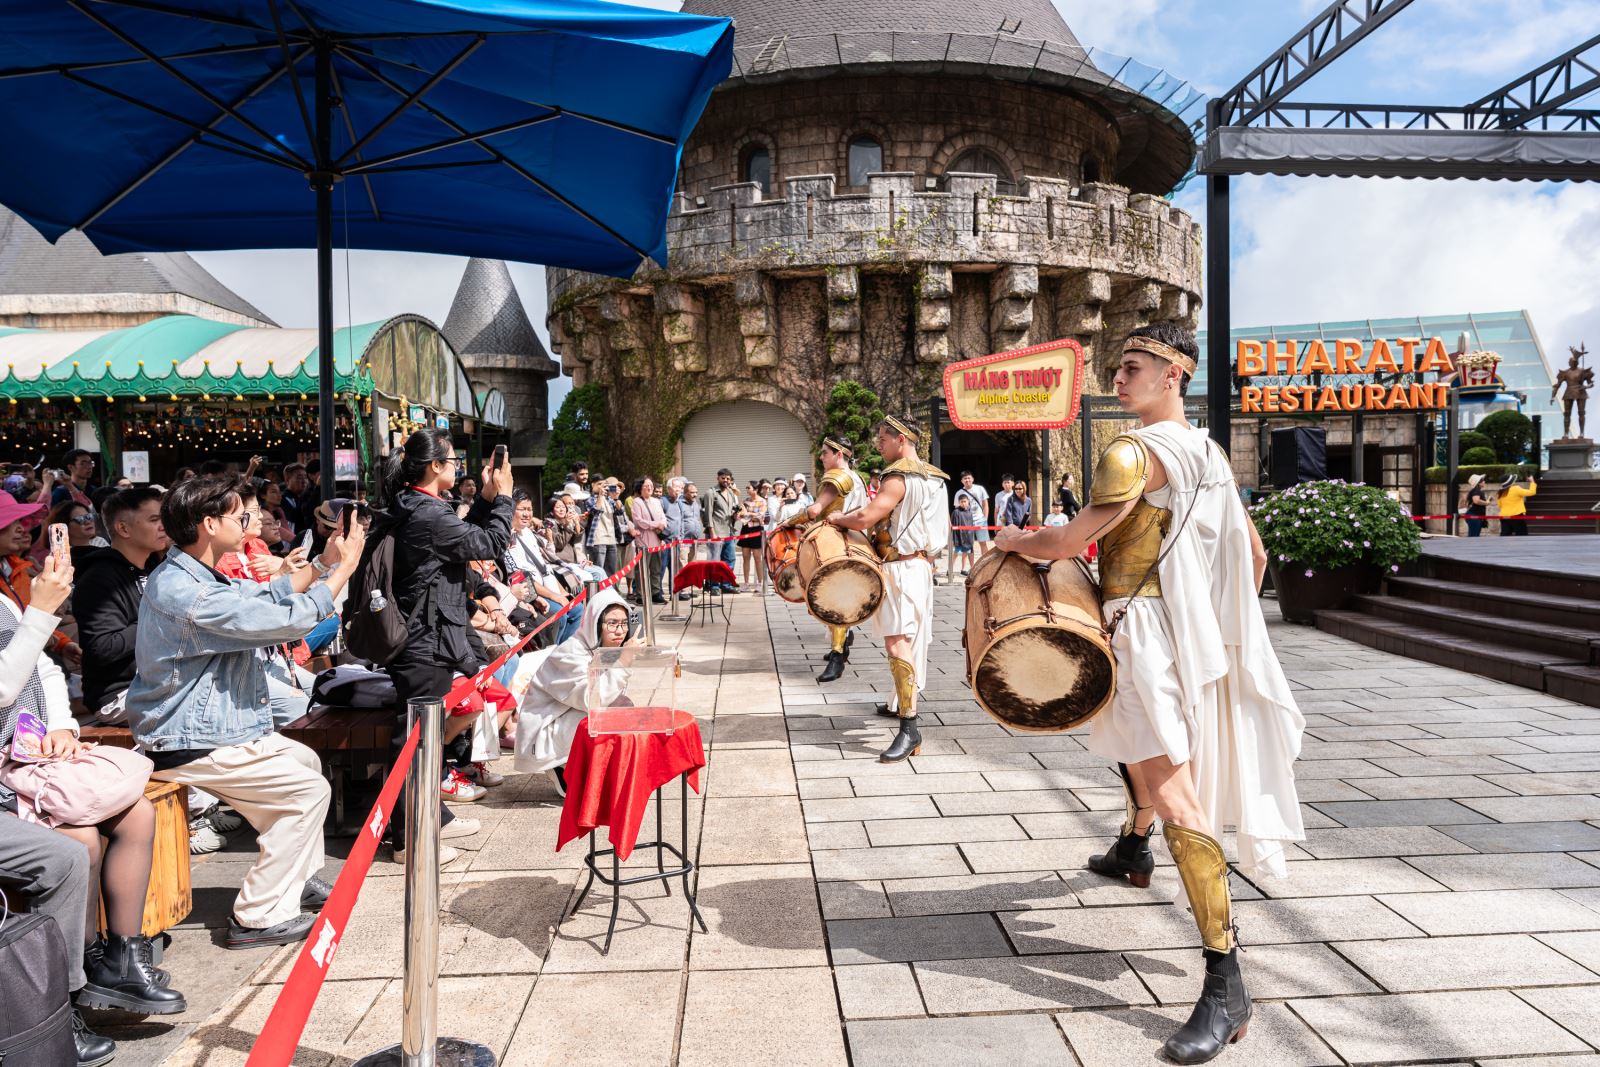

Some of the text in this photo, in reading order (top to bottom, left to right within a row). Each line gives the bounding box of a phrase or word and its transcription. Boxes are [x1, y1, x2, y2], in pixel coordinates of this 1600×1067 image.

[1237, 336, 1455, 377] BHARATA
[963, 367, 1010, 391] MÁNG
[978, 390, 1051, 406] Alpine Coaster
[1241, 382, 1452, 413] RESTAURANT
